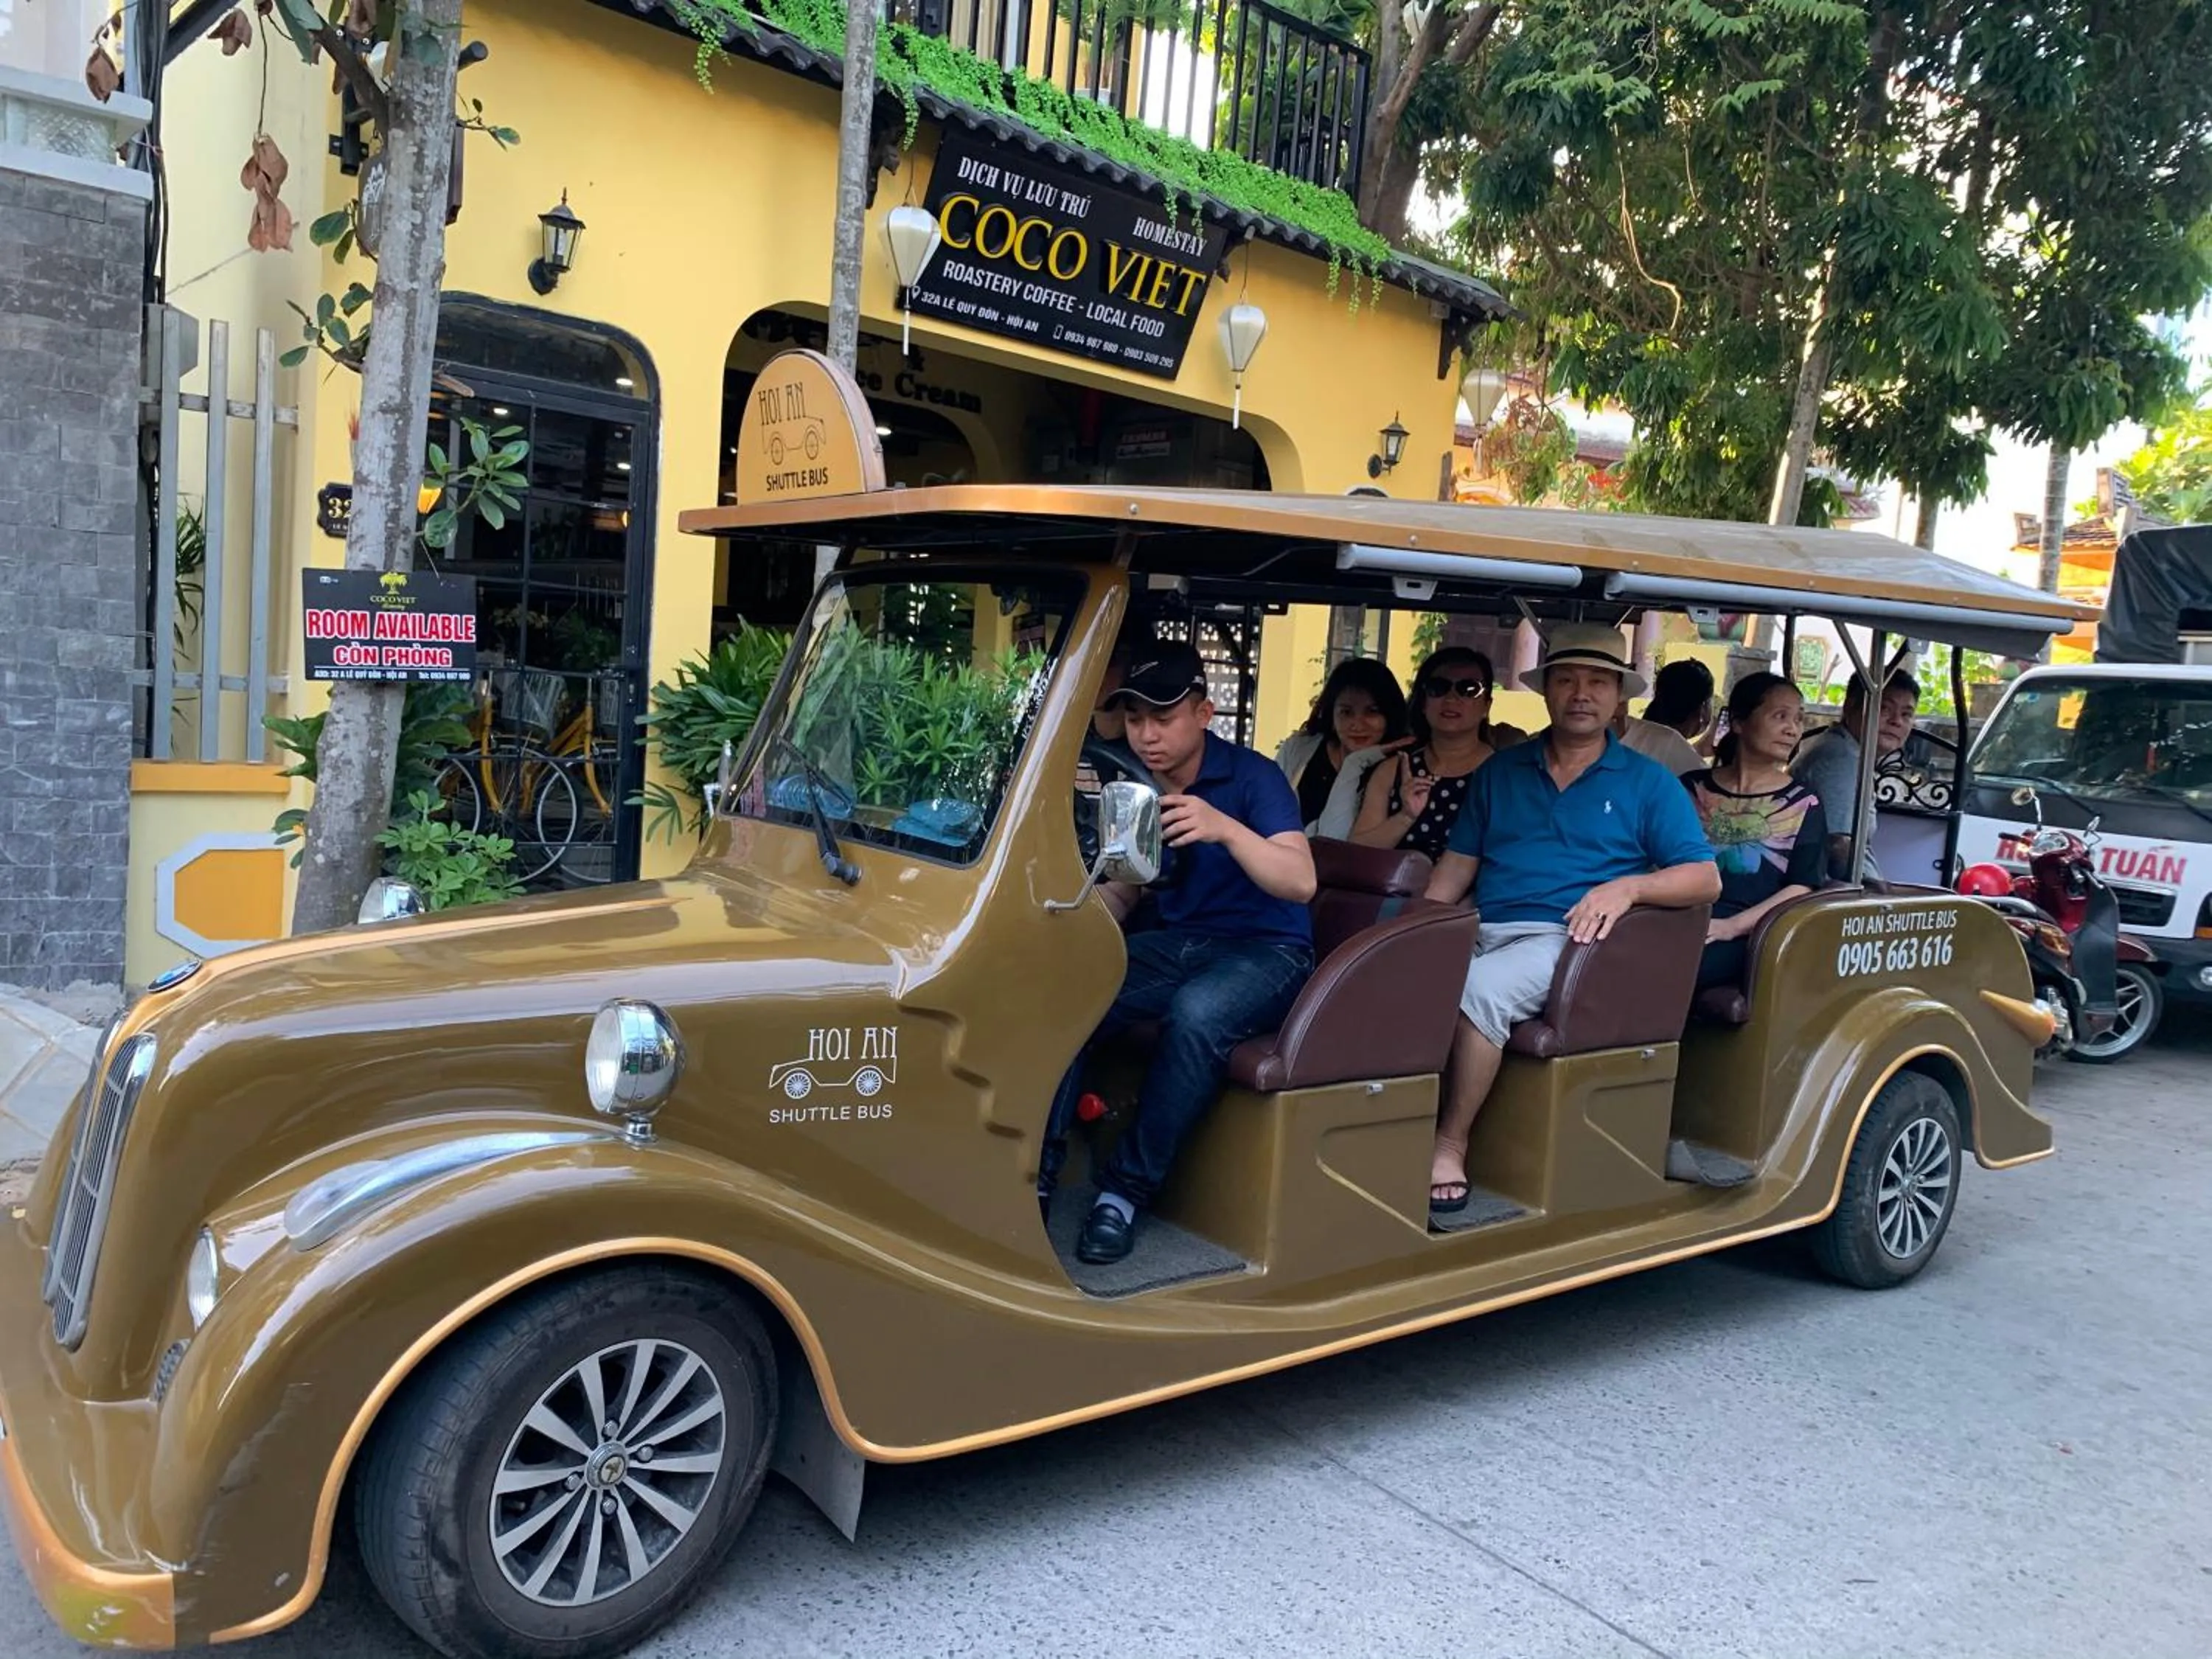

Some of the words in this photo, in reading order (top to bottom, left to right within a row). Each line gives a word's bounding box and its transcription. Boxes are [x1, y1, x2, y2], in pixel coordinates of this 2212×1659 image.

[957, 156, 1001, 189] DỊCH
[1003, 171, 1026, 199] VỤ
[1025, 180, 1059, 208] LƯU
[939, 194, 1088, 281] COCO
[1107, 242, 1207, 316] VIET
[1133, 216, 1208, 257] HOMESTAY
[921, 291, 941, 306] 32A
[1024, 319, 1039, 332] AN
[943, 260, 1023, 297] ROASTERY
[1023, 282, 1077, 314] COFFEE
[1086, 302, 1127, 328] LOCAL
[1130, 314, 1166, 338] FOOD
[757, 387, 784, 426] HOI
[785, 381, 807, 421] AN
[894, 372, 983, 414] Cream
[766, 468, 808, 492] SHUTTLE
[808, 467, 829, 487] BUS
[307, 608, 369, 639] ROOM
[374, 611, 476, 643] AVAILABLE
[1841, 916, 1865, 937] HOI
[1865, 914, 1885, 934] AN
[1885, 911, 1935, 933] SHUTTLE
[1935, 909, 1958, 929] BUS
[1837, 939, 1884, 978] 0905
[1885, 937, 1919, 972] 663
[1921, 933, 1954, 968] 616
[809, 1028, 852, 1061] HOI
[860, 1026, 898, 1060] AN
[769, 1105, 852, 1124] SHUTTLE
[858, 1103, 894, 1119] BUS
